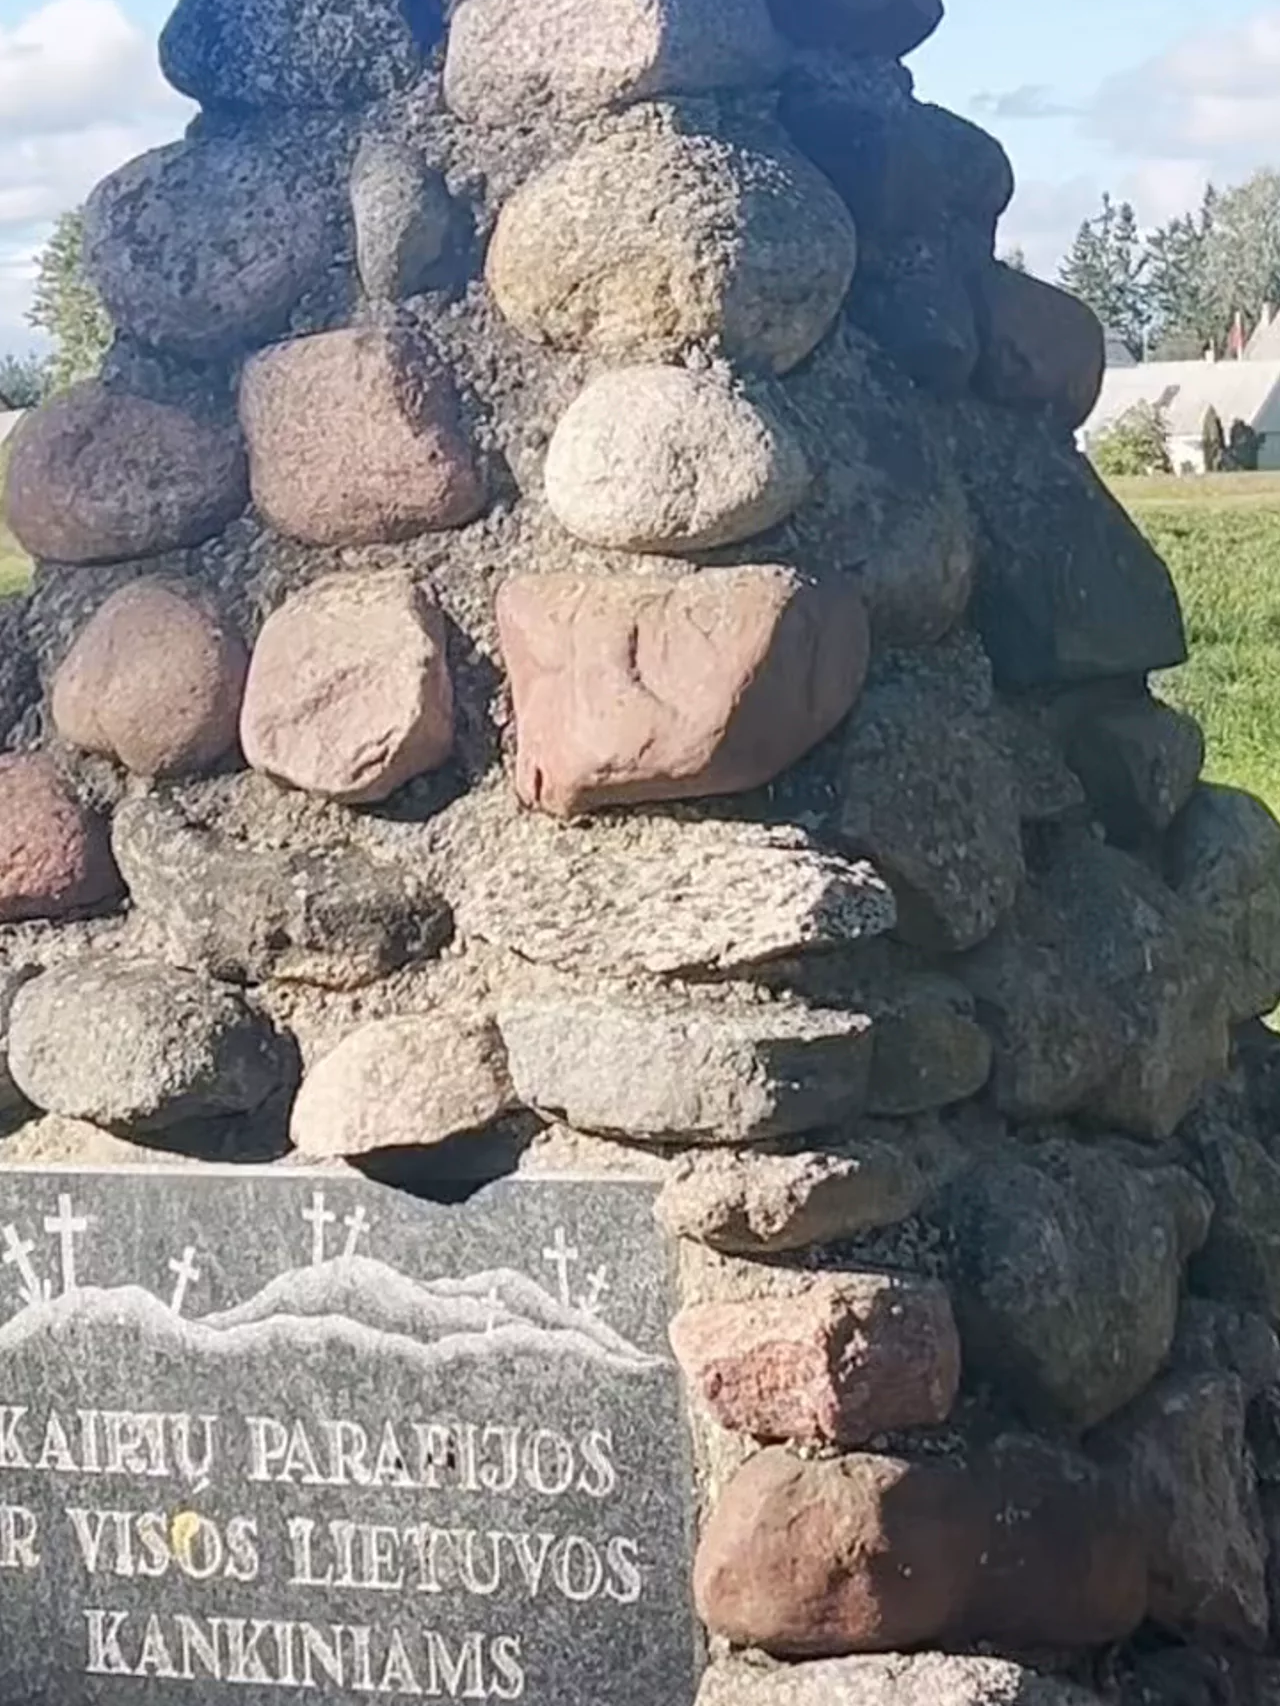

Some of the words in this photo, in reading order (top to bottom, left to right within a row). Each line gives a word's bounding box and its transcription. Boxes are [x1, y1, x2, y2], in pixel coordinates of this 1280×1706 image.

[244, 1415, 617, 1497] PARAPIJOS
[65, 1507, 260, 1582] VISOS
[287, 1515, 643, 1605] LIETUVOS
[82, 1608, 525, 1701] KANKINIAMS
